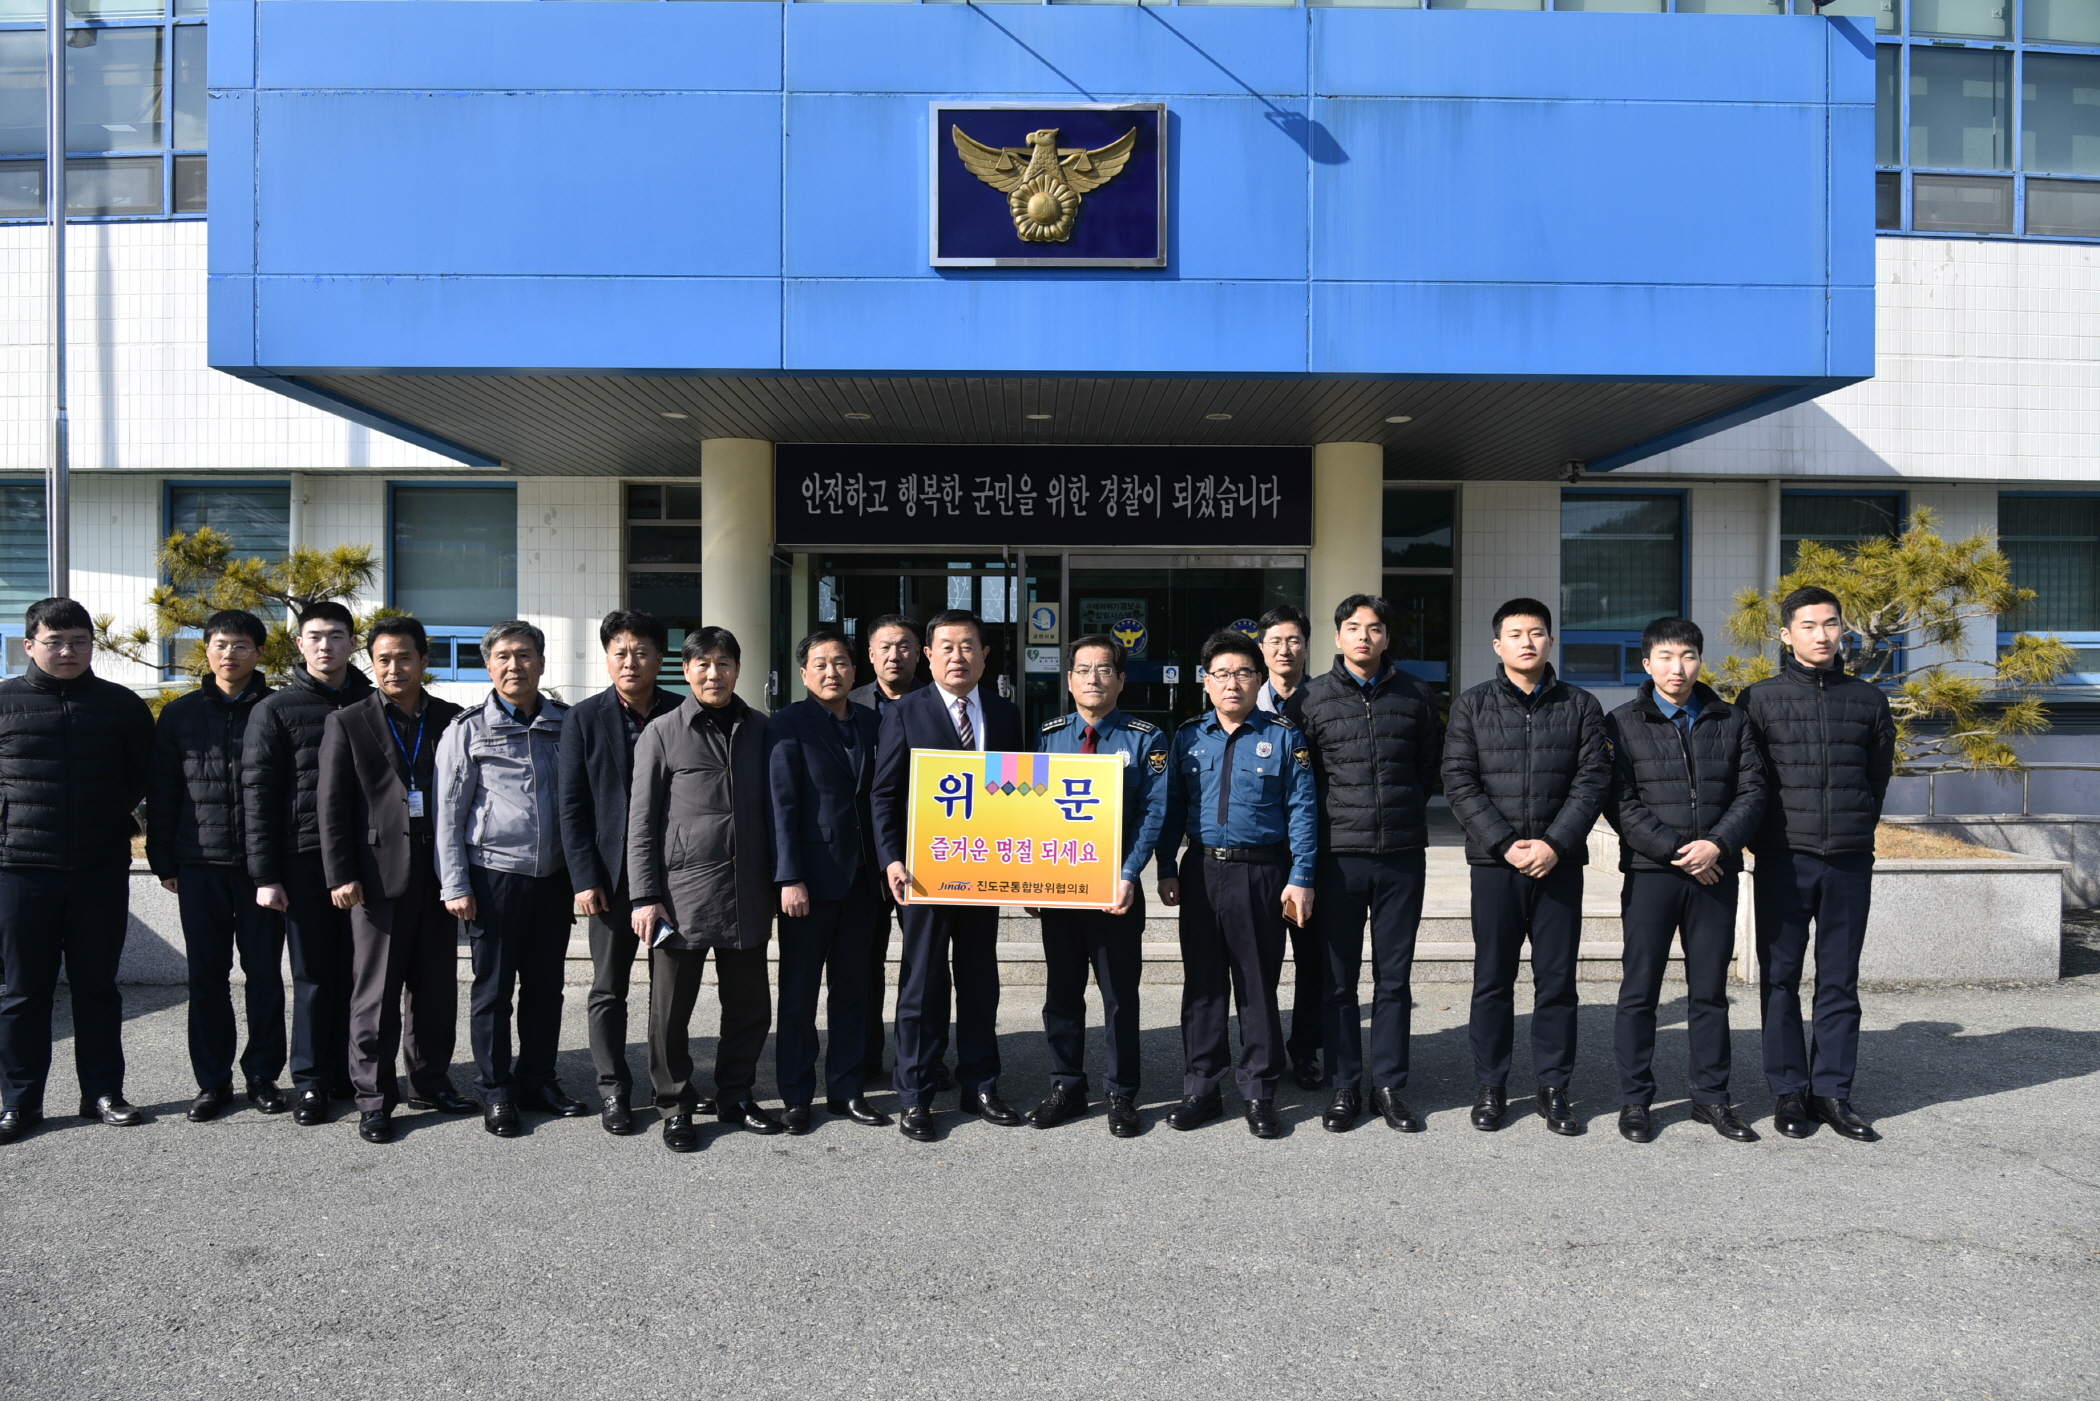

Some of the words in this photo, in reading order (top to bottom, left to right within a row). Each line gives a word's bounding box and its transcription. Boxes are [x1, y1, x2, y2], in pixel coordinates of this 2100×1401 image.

[801, 473, 889, 516] 안전하고
[898, 474, 963, 517] 행복한
[971, 474, 1037, 516] 군민을
[1046, 475, 1090, 518] 위한
[1098, 475, 1161, 518] 경찰이
[1173, 475, 1281, 519] 되겠습니다
[933, 773, 974, 820] 위
[1054, 778, 1100, 821] 문
[931, 836, 989, 862] 즐거운
[997, 838, 1033, 863] 명절
[1041, 840, 1099, 865] 되세요
[938, 881, 967, 891] Jindo
[977, 880, 1089, 895] 진도군통합방위협의회
